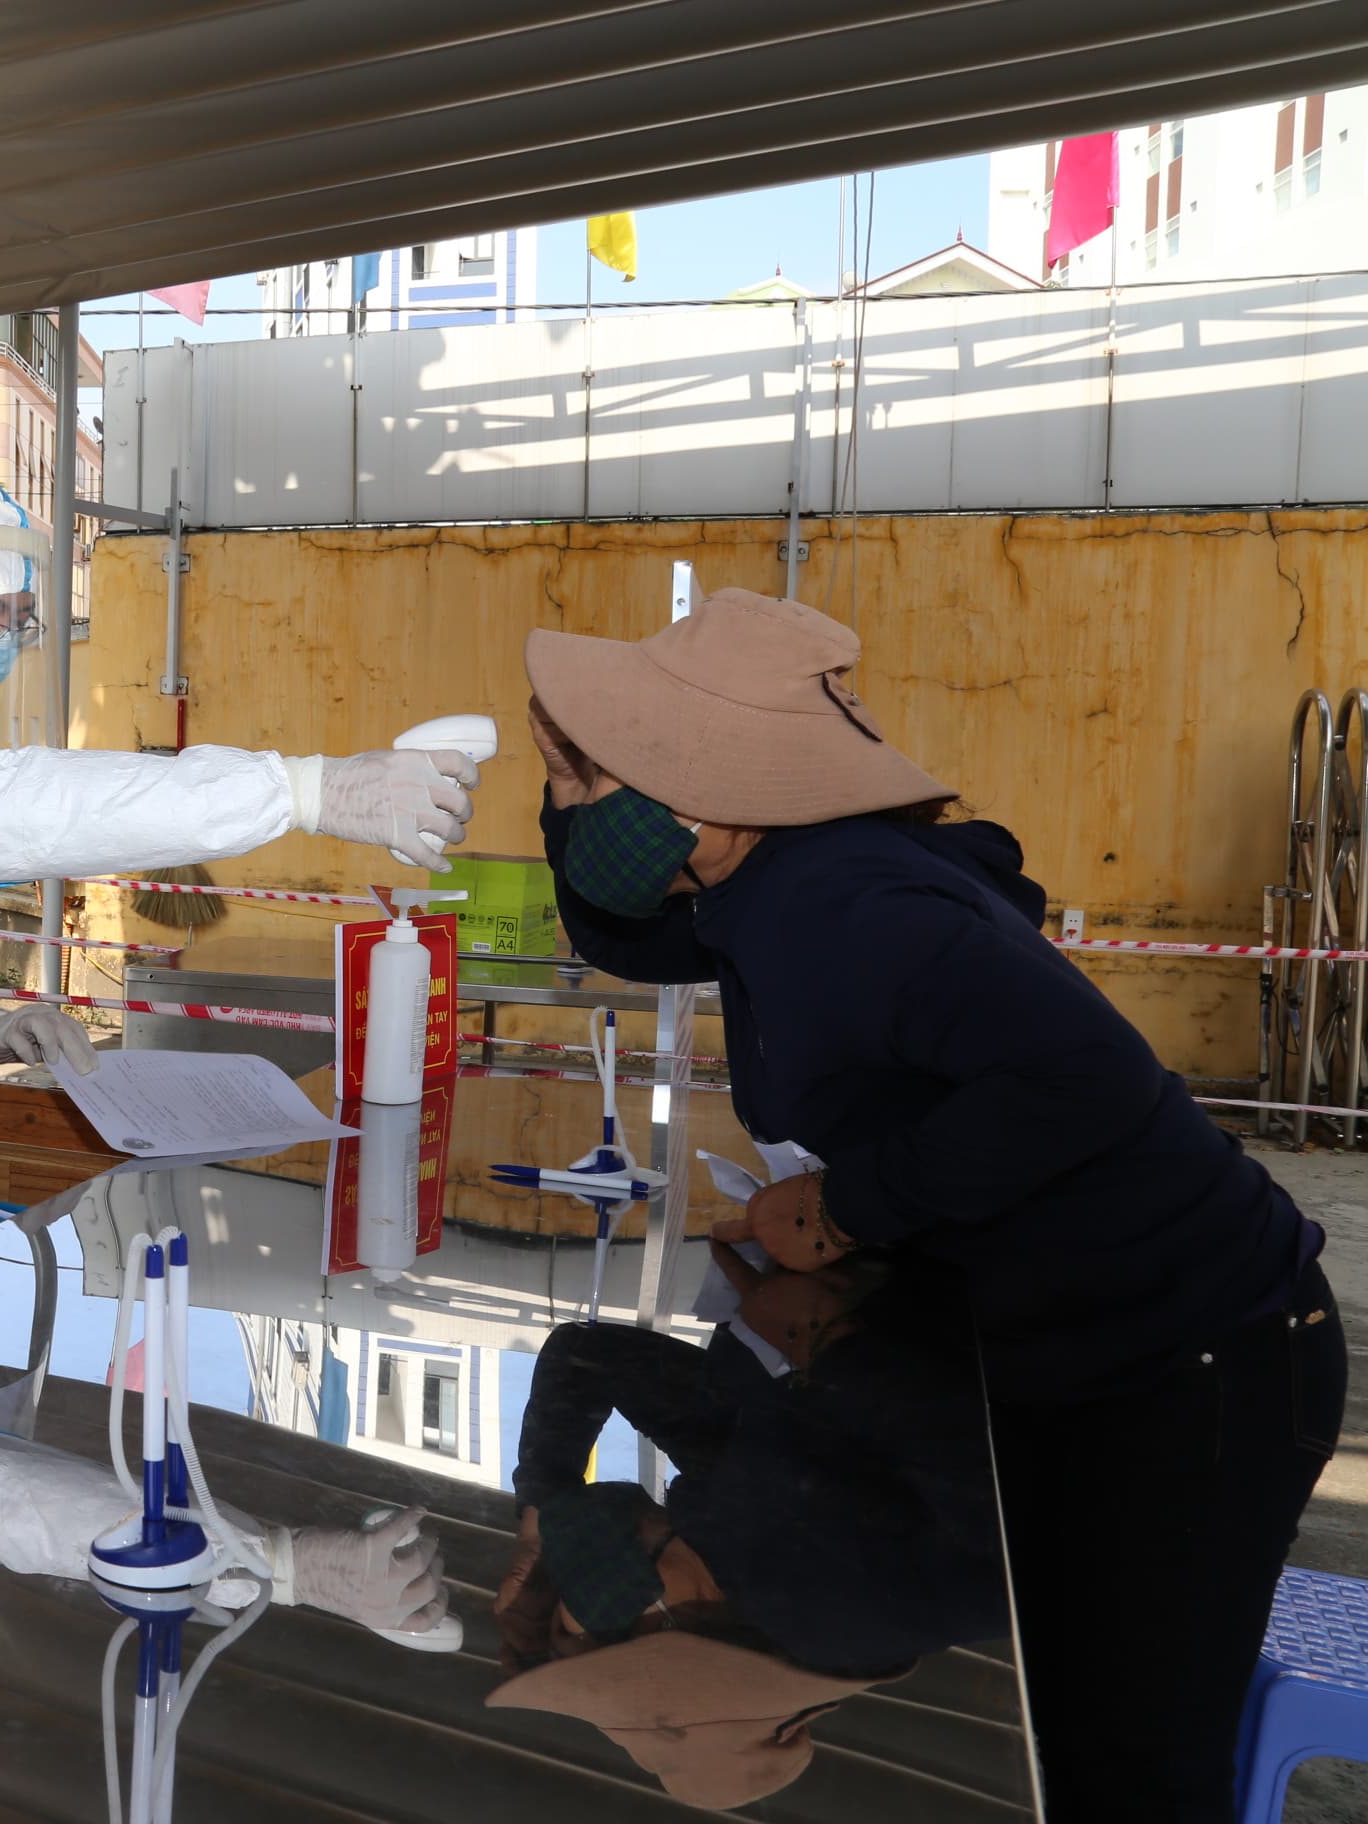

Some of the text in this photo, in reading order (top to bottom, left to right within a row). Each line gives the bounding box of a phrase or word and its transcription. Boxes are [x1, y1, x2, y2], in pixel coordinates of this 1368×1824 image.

[499, 922, 514, 933] 70
[497, 940, 514, 951] A4
[355, 985, 369, 1010] SÁ
[435, 1011, 448, 1024] TAY
[426, 1032, 440, 1048] IỆN
